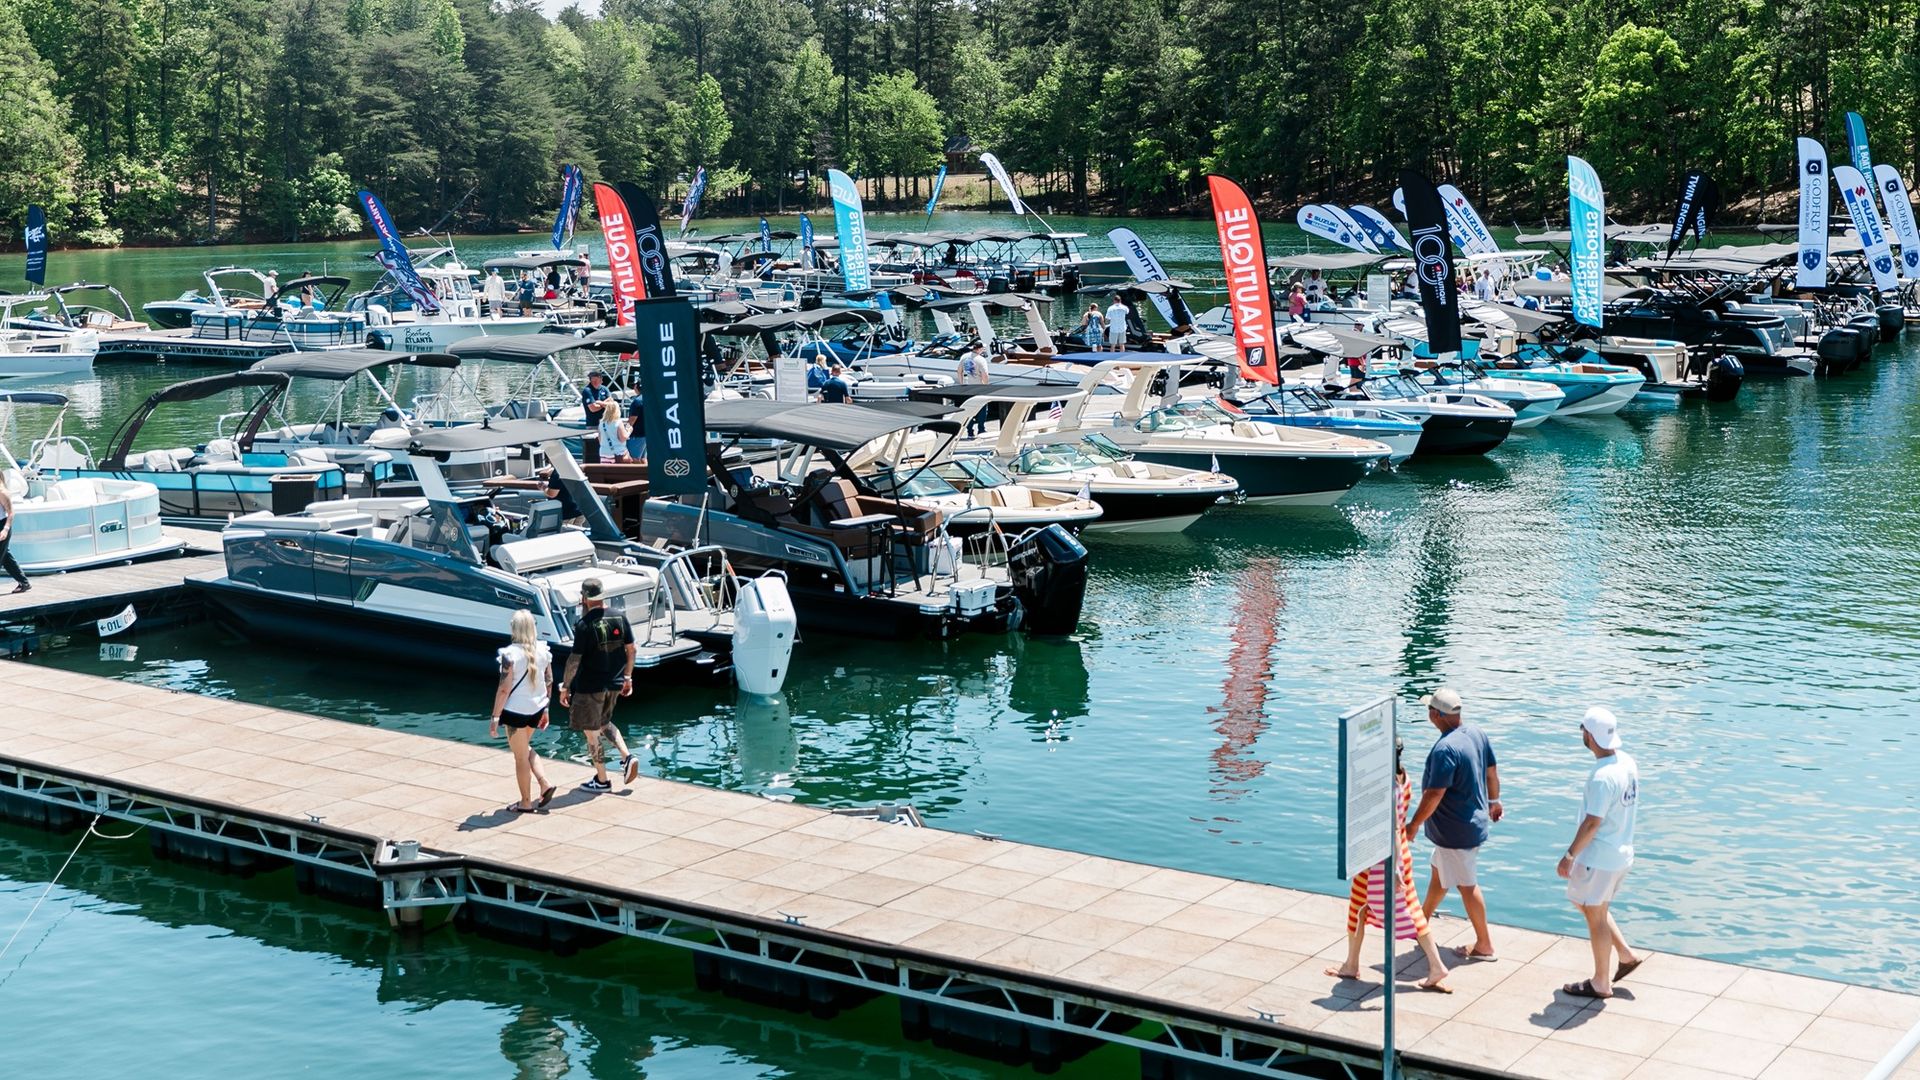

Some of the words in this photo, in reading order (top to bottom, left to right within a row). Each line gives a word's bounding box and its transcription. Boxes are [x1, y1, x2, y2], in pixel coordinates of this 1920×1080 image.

[1684, 175, 1700, 201] TWIN
[1314, 215, 1339, 228] SUZUKI
[1672, 203, 1690, 240] ENGINE
[1697, 206, 1706, 239] NGIN
[1811, 178, 1822, 233] GODFREY
[1849, 202, 1868, 233] MARINE
[1861, 198, 1883, 244] SUZUKI
[1894, 193, 1912, 238] GODFREY
[1462, 206, 1487, 241] SUZUKI
[1436, 271, 1447, 305] NAUTIQUE
[404, 327, 431, 338] Boating
[659, 322, 682, 449] BALISE
[106, 619, 122, 632] 01L
